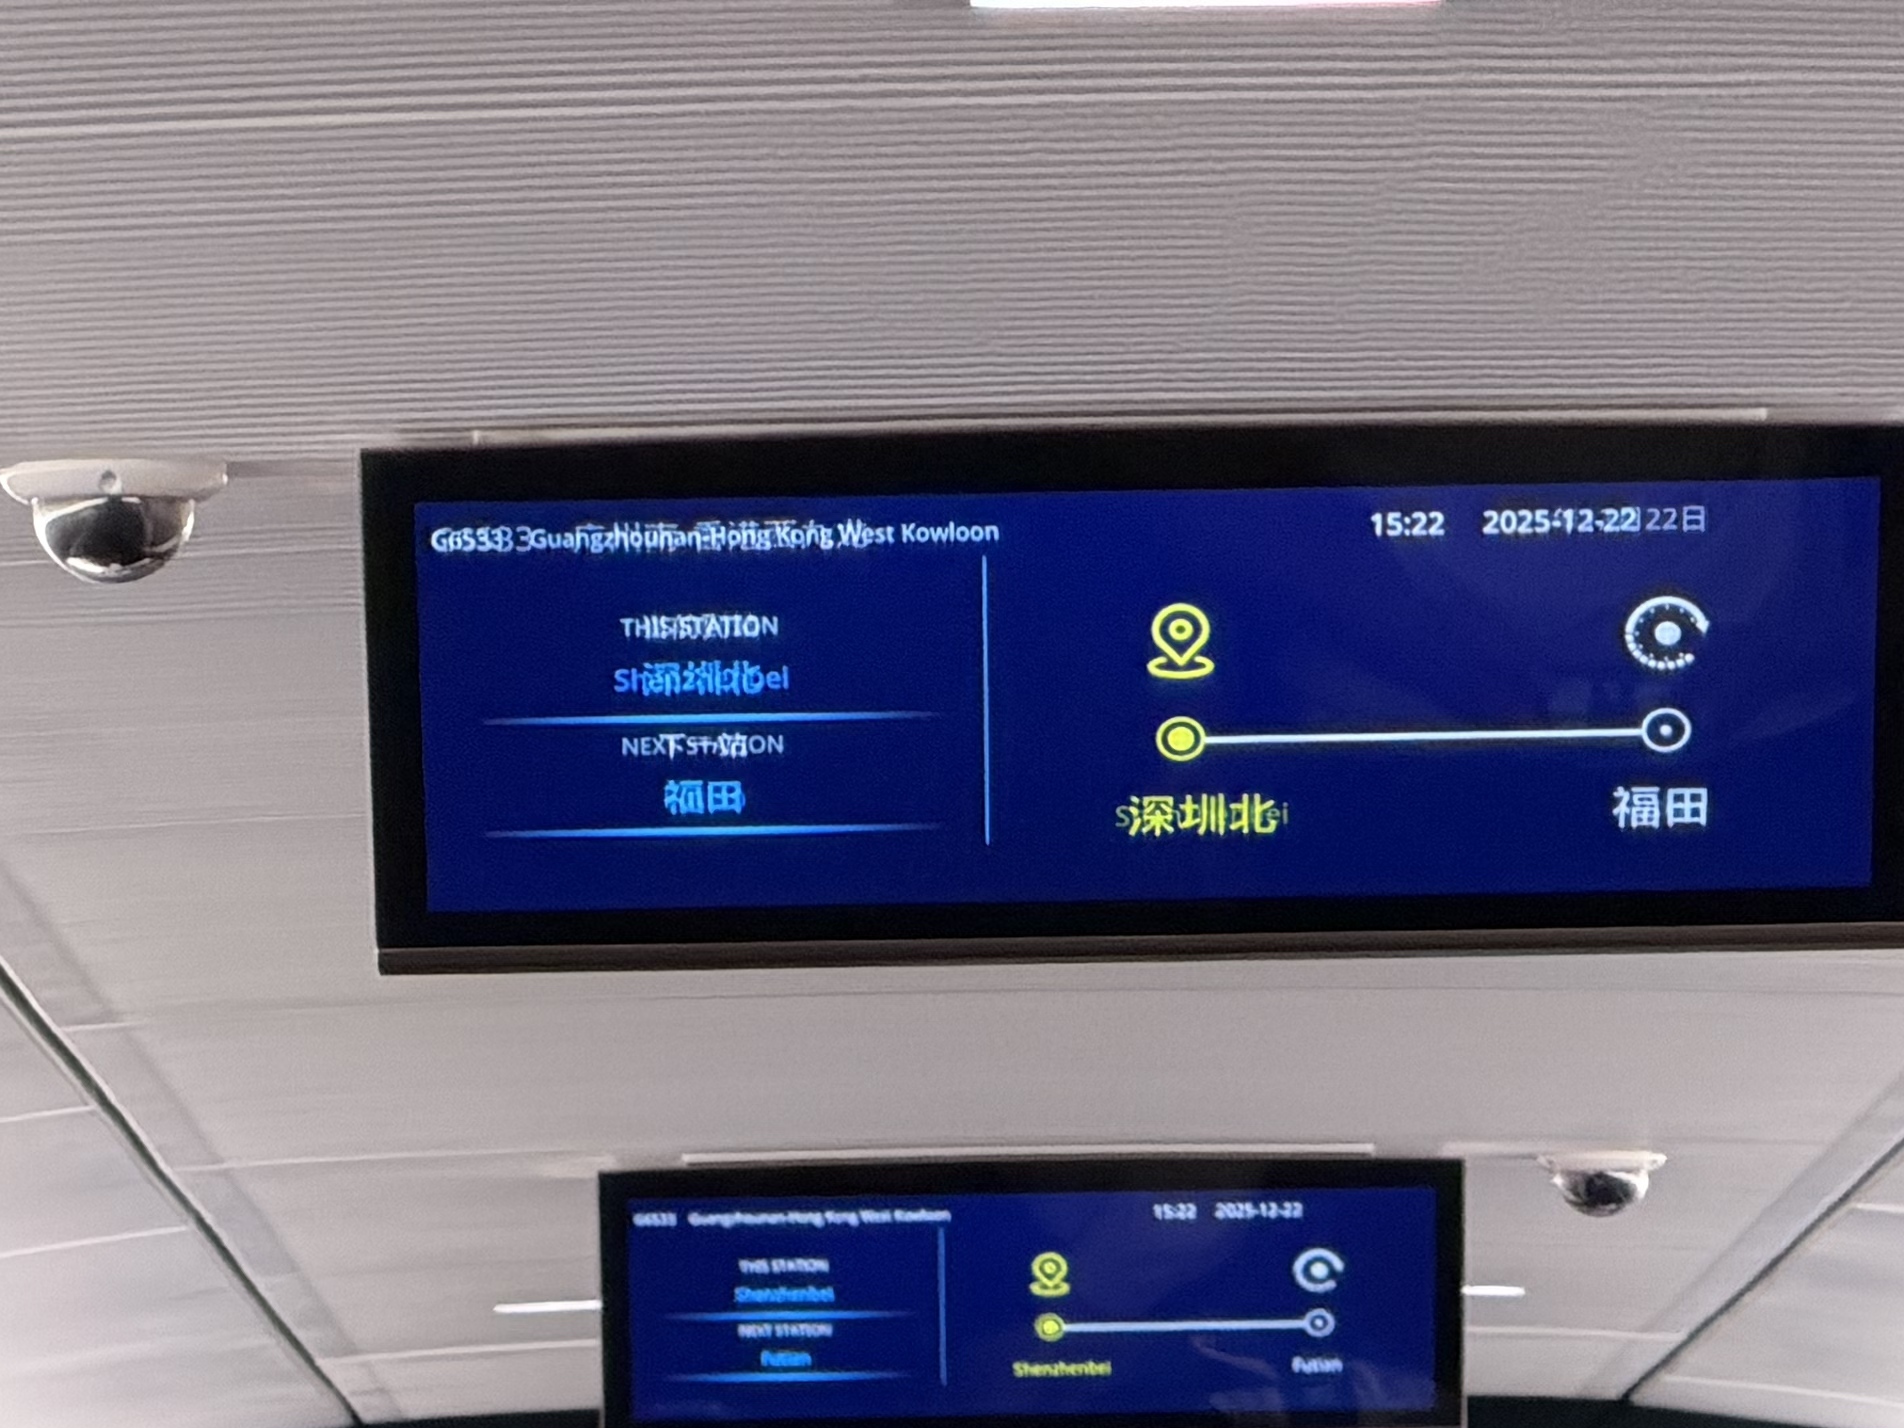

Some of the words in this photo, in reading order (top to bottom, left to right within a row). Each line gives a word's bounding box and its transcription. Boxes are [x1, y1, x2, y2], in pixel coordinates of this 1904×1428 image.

[900, 521, 1000, 543] Kowloon
[1371, 511, 1445, 537] 15:22
[1127, 792, 1276, 837] 深圳北
[1612, 785, 1709, 829] 福田
